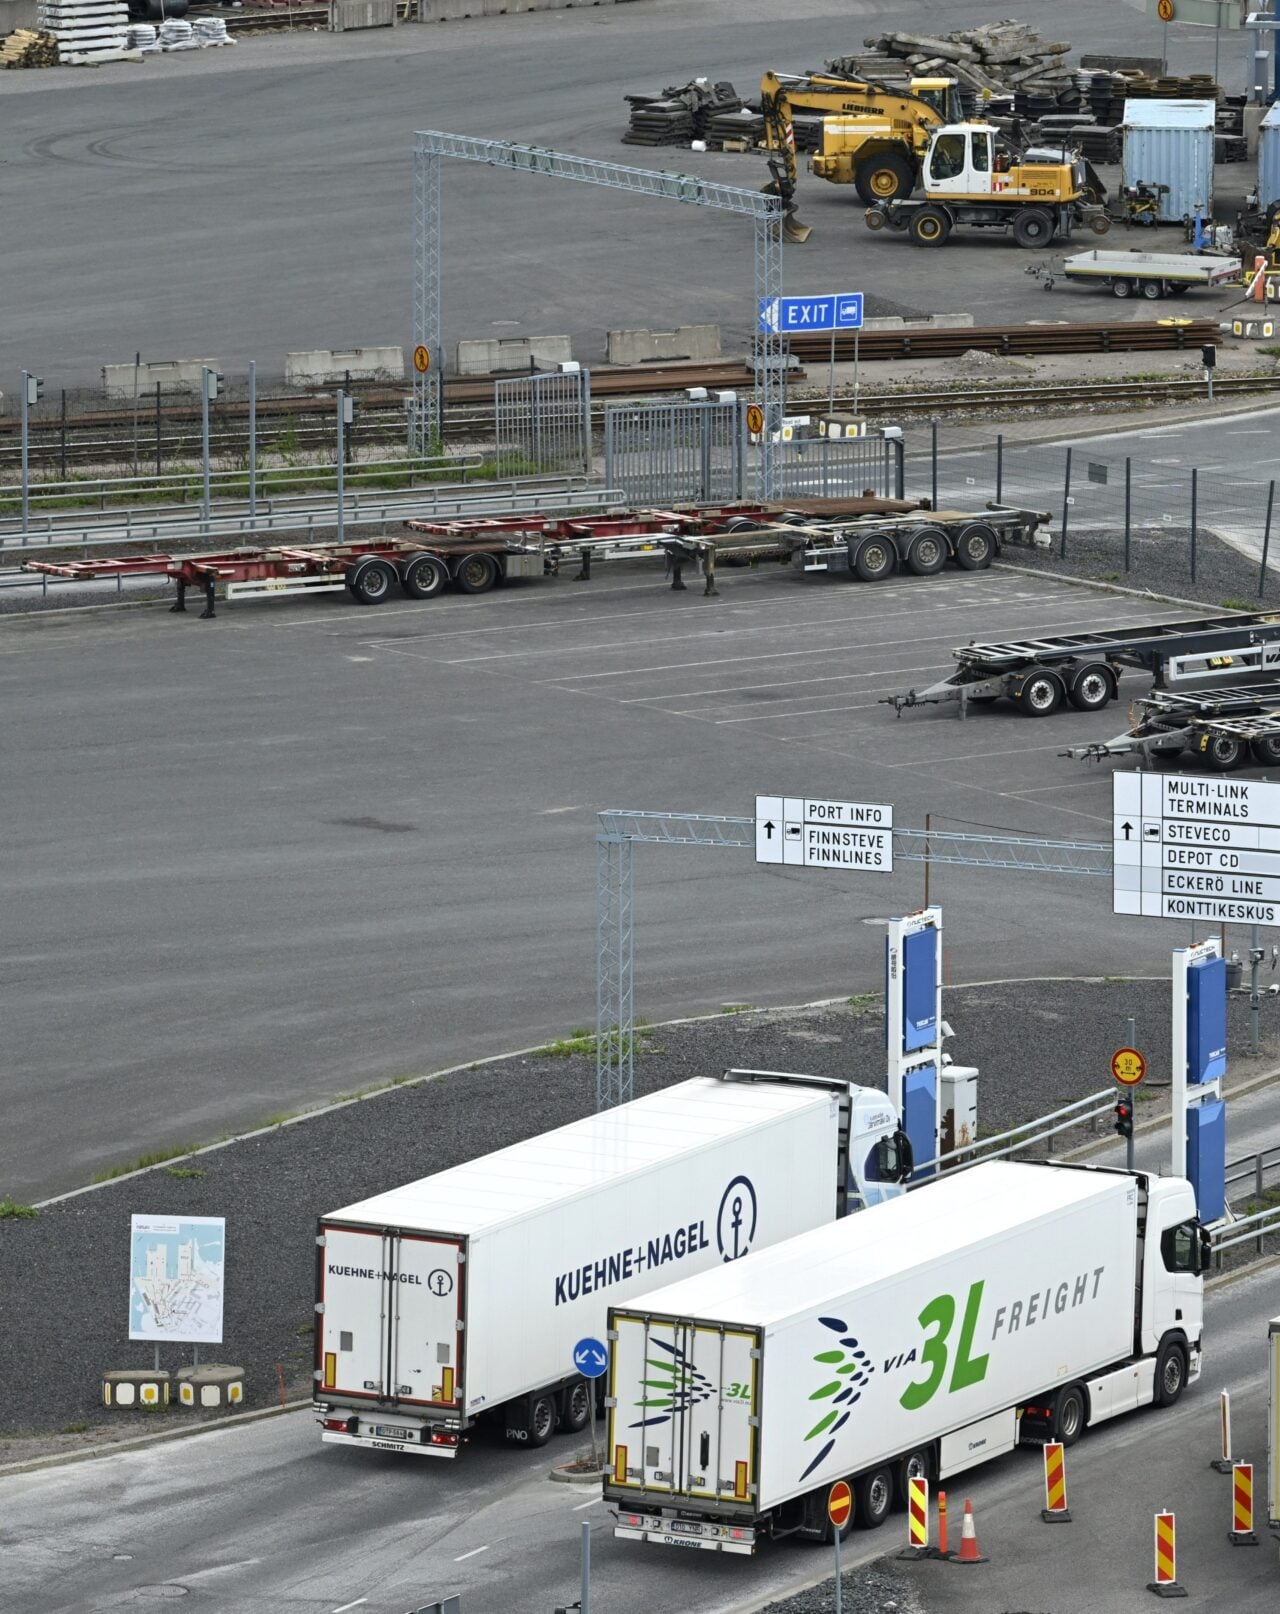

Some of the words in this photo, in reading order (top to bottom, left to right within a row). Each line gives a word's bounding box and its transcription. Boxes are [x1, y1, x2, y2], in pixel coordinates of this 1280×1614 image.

[842, 103, 884, 115] LIEBHERR
[788, 304, 828, 324] EXIT
[1168, 781, 1249, 800] MULTI-LINK
[809, 804, 843, 820] PORT
[850, 807, 882, 823] INFO
[1168, 798, 1249, 818] TERMINALS
[809, 830, 884, 849] FINNSTEVE
[1168, 824, 1231, 842] STEVECO
[809, 847, 882, 866] FINNLINES
[1168, 849, 1213, 865] DEPOT
[1220, 854, 1239, 868] CD
[1168, 874, 1224, 892] ECKERÖ
[1232, 880, 1264, 895] LINE
[1167, 899, 1275, 921] KONTTIKESKUS
[992, 1266, 1105, 1340] FREIGHT
[899, 1279, 990, 1410] 3L
[884, 1348, 918, 1374] VIA
[726, 1382, 752, 1400] 3L
[506, 1428, 529, 1441] PNO
[372, 1441, 405, 1451] SCHMITZ
[673, 1539, 702, 1549] KRONE
